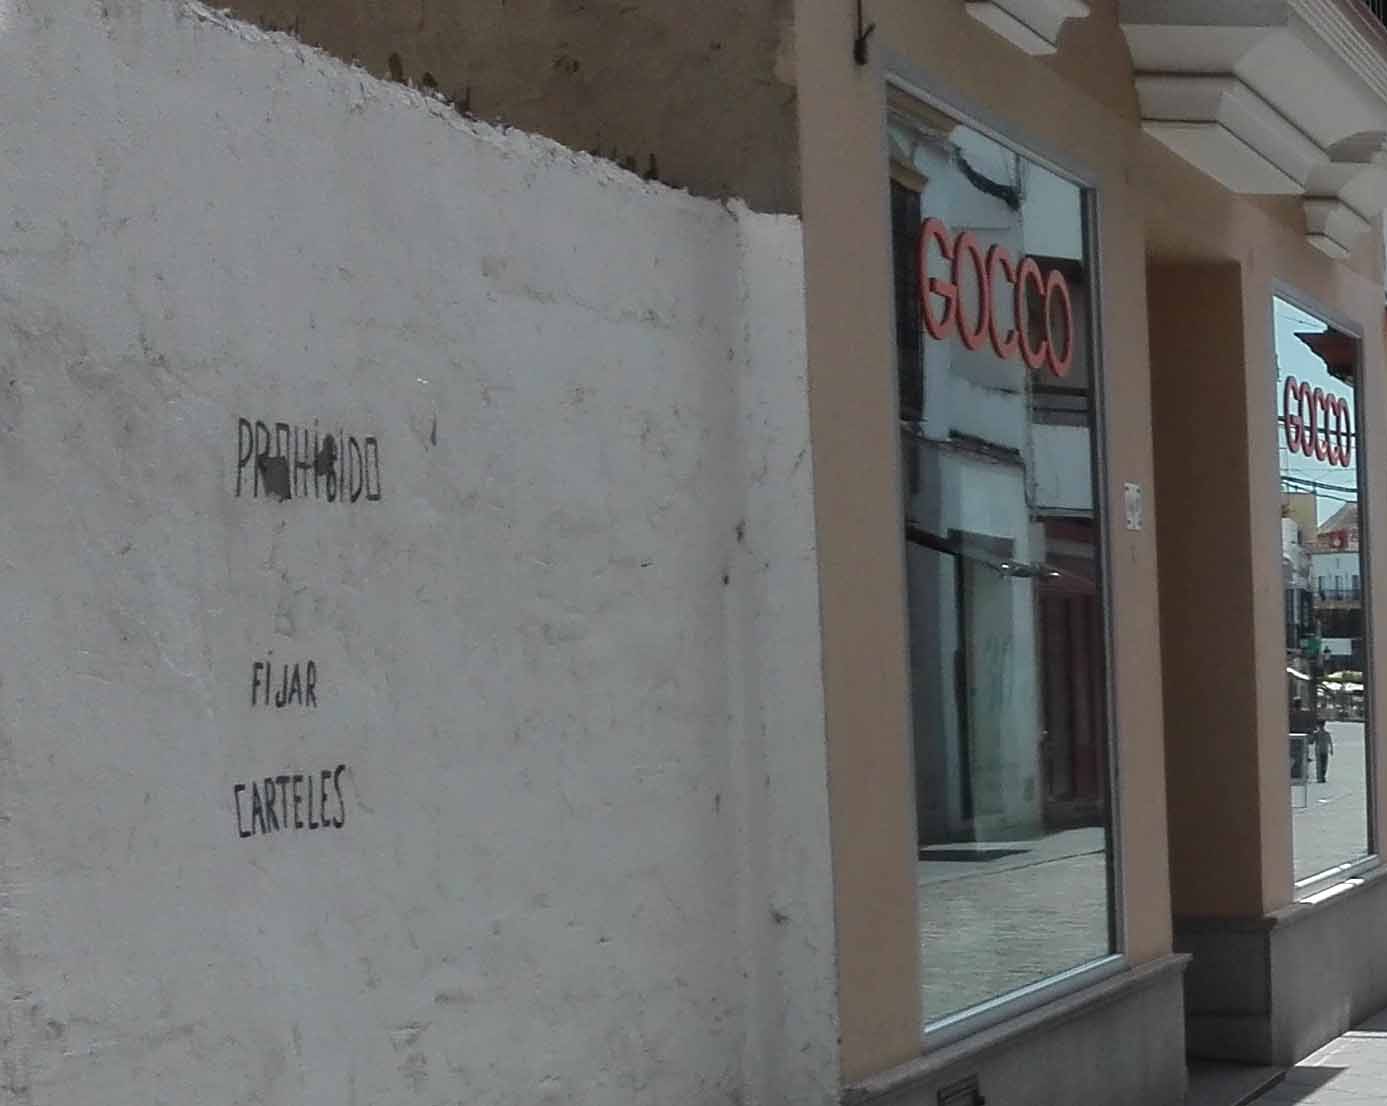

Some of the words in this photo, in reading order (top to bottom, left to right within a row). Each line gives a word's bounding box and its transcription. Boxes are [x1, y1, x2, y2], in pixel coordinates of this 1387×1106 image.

[918, 216, 1073, 377] GOCCO
[1284, 375, 1352, 468] GOCCO
[251, 650, 319, 708] FIJAR
[233, 764, 347, 838] CARTELES
